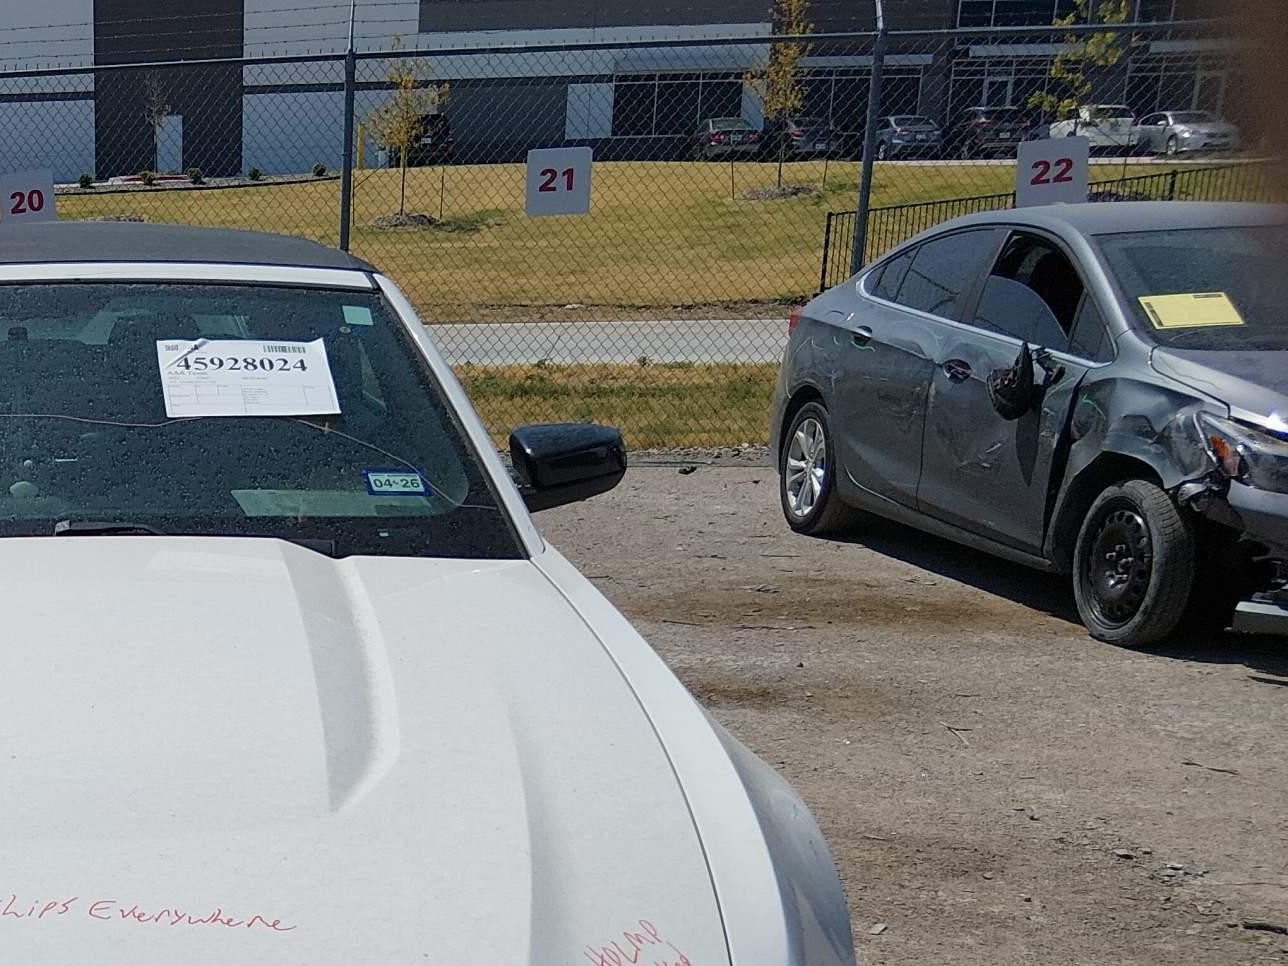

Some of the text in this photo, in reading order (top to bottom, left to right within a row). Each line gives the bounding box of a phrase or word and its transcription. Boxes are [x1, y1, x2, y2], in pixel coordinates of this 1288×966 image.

[539, 168, 574, 192] 21
[1030, 158, 1073, 185] 22
[10, 189, 44, 214] 20
[176, 356, 309, 371] 45928024
[88, 900, 297, 931] Everywhere
